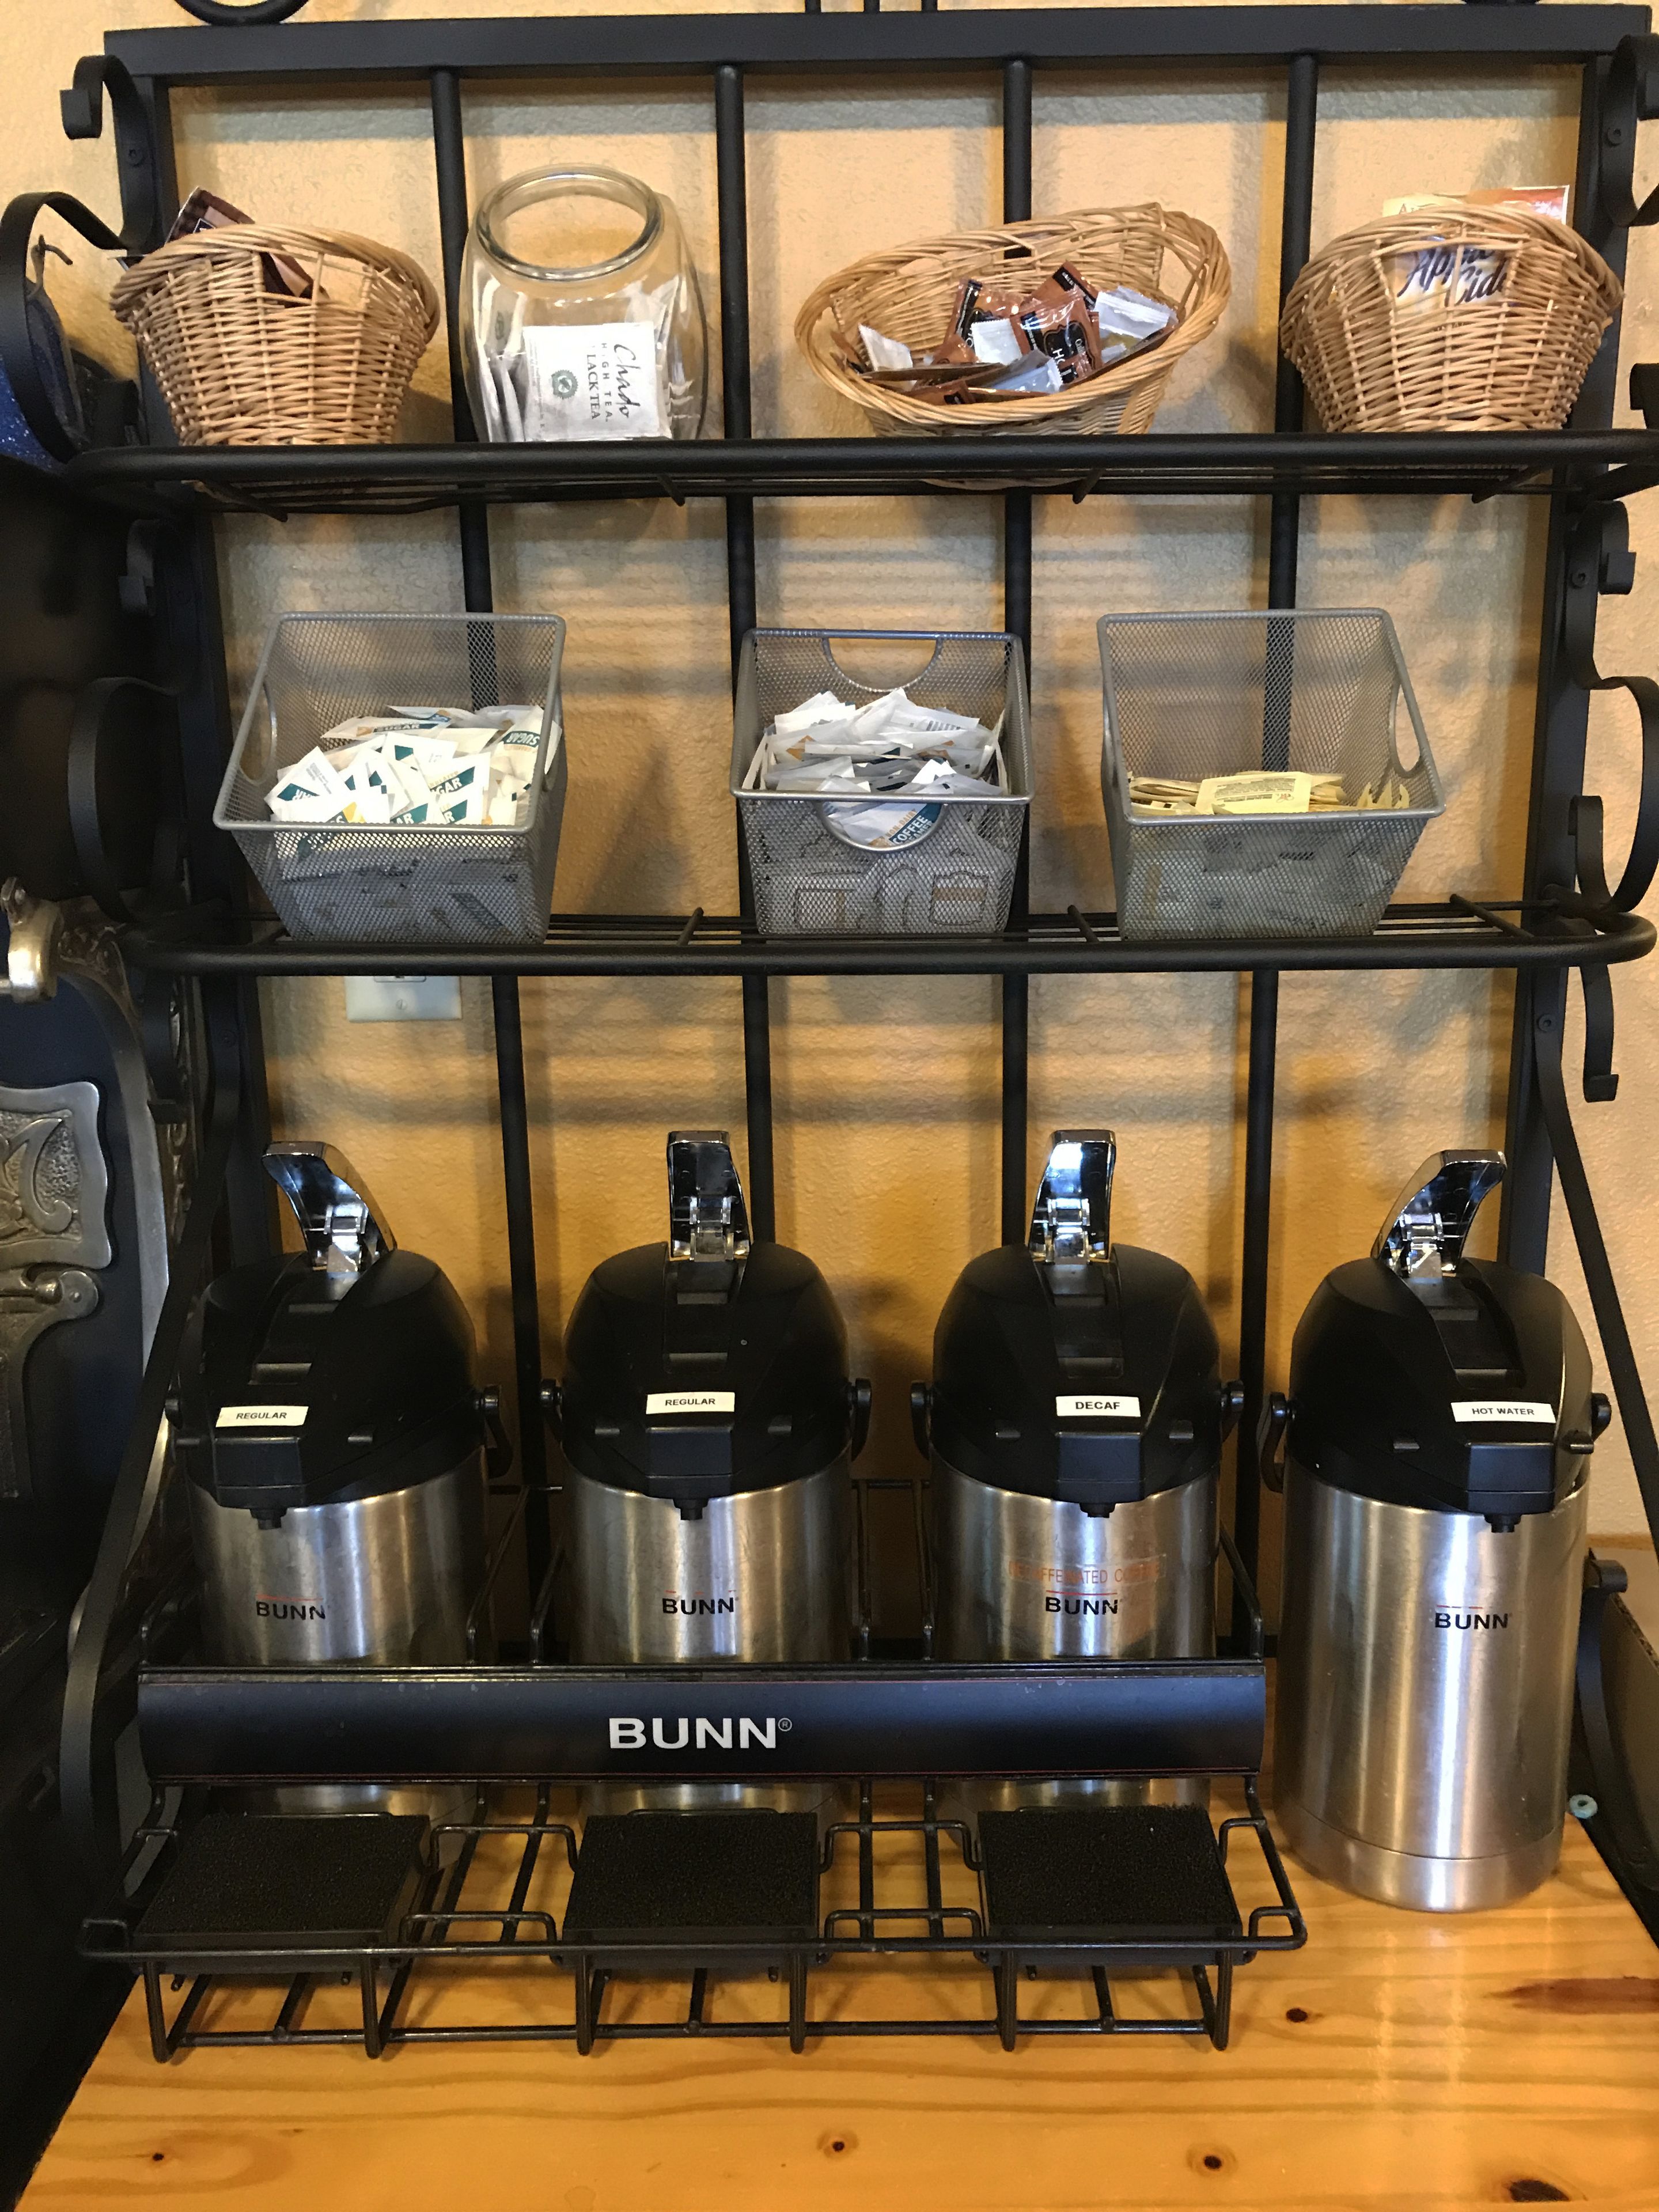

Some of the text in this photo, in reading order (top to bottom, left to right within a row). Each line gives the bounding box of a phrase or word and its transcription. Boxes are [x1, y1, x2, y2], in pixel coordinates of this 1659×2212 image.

[586, 347, 601, 419] LACK TEA
[506, 732, 540, 745] SUGAR
[892, 815, 928, 844] COFFEE
[665, 1398, 716, 1406] REGULAR
[1075, 1402, 1120, 1410] DECAF
[236, 1412, 287, 1420] REGULAR
[256, 1601, 326, 1620] BUNN
[662, 1597, 734, 1615] BUNN
[1045, 1596, 1119, 1615] BUNN
[1434, 1612, 1509, 1630] BUNN
